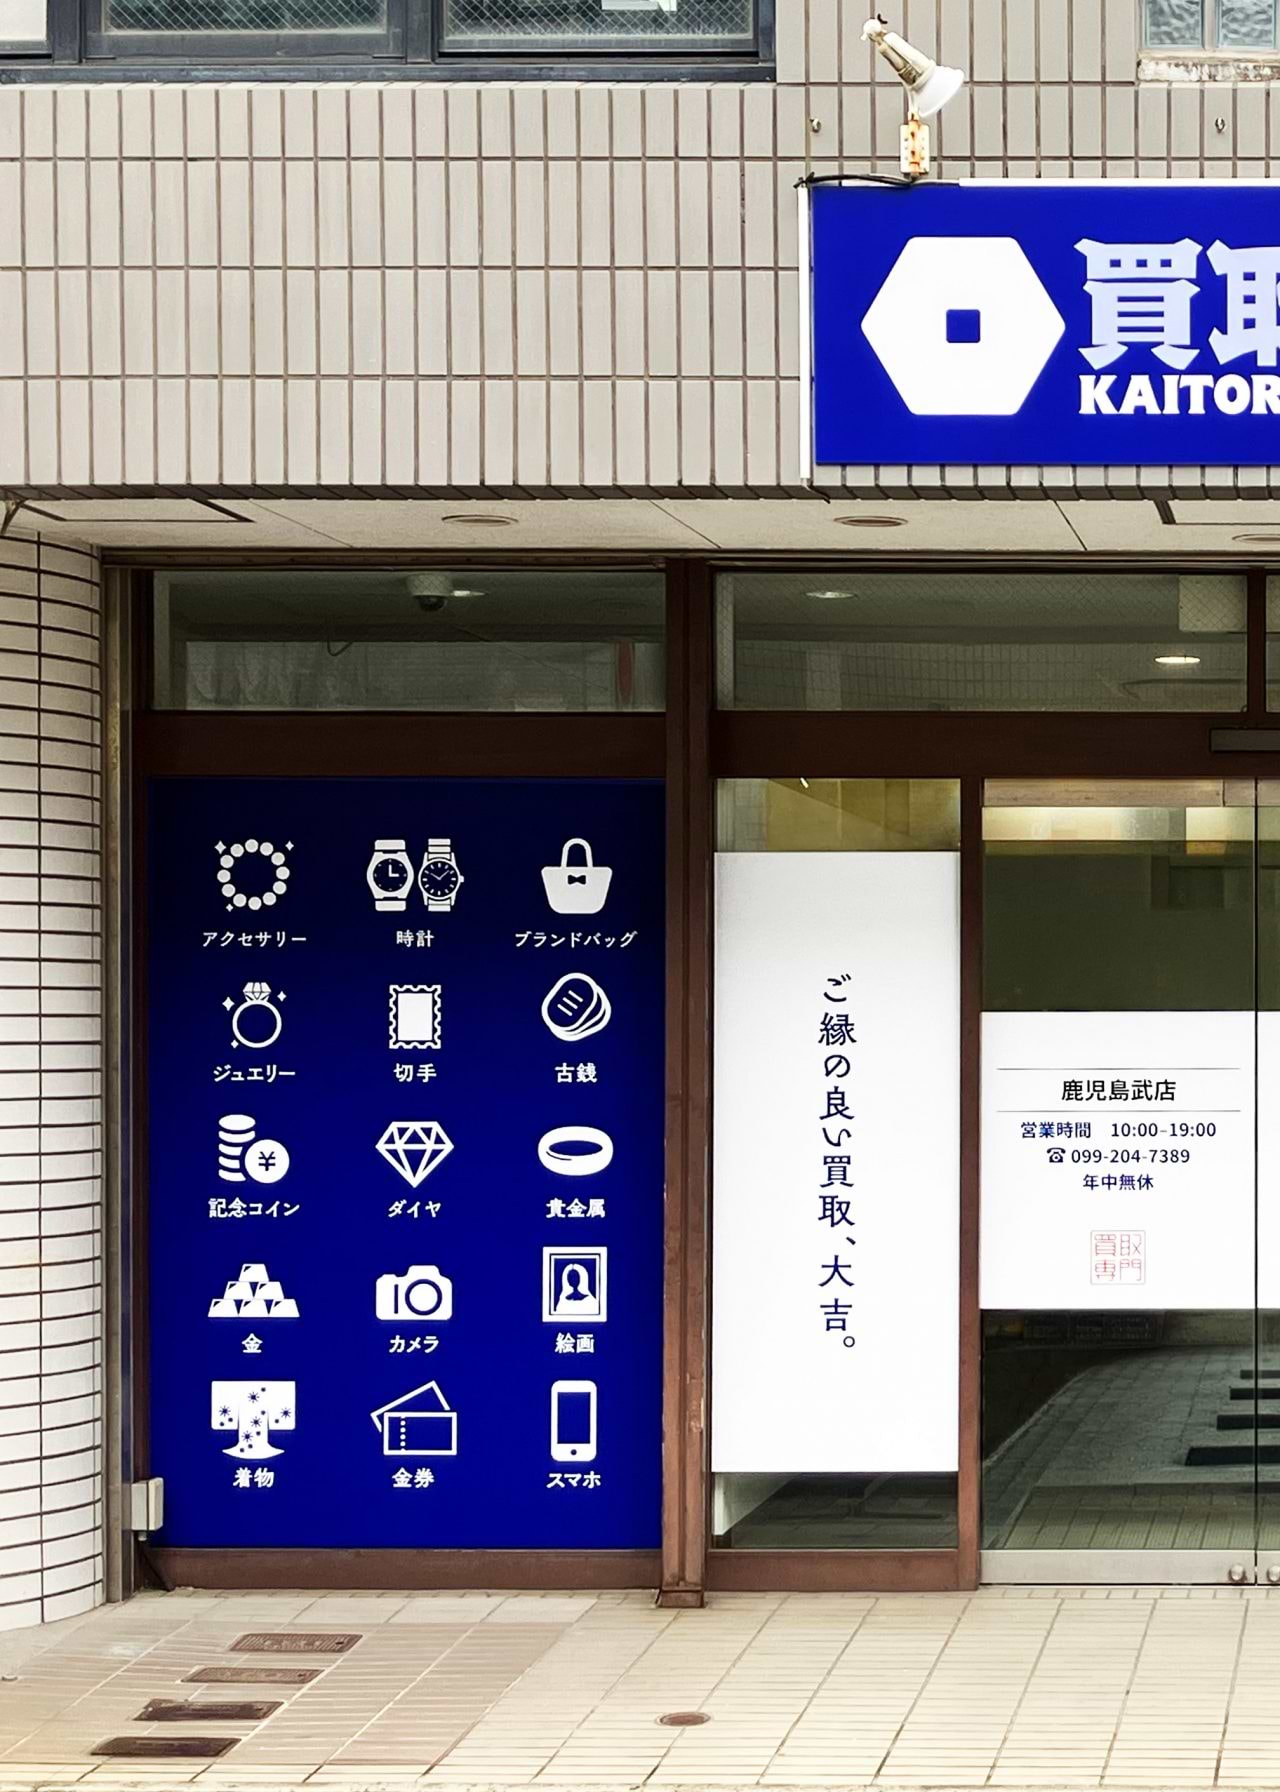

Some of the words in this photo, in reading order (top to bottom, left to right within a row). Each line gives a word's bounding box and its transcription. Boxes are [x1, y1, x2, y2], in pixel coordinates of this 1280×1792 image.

[202, 931, 307, 948] アクセサリー
[396, 929, 435, 948] 時計
[515, 930, 638, 948] ブランドバッグ
[213, 1064, 296, 1083] ジュエリー
[393, 1062, 437, 1083] 切手
[554, 1062, 598, 1083] 古銭
[1061, 1078, 1177, 1102] 鹿児島武店
[1020, 1121, 1091, 1139] 営業時間
[817, 973, 857, 1348] ご縁の良い買取、大吉。
[1071, 1149, 1190, 1164] 099-204-7389
[1082, 1173, 1154, 1191] 年中無休
[208, 1196, 300, 1218] 記念コイン
[388, 1199, 441, 1219] ダイヤ
[545, 1197, 606, 1219] 貴金属
[241, 1333, 263, 1354] 金
[388, 1334, 439, 1354] カメラ
[554, 1332, 595, 1354] 絵画
[232, 1467, 275, 1488] 着物
[391, 1467, 435, 1489] 金券
[546, 1470, 601, 1489] スマホ
